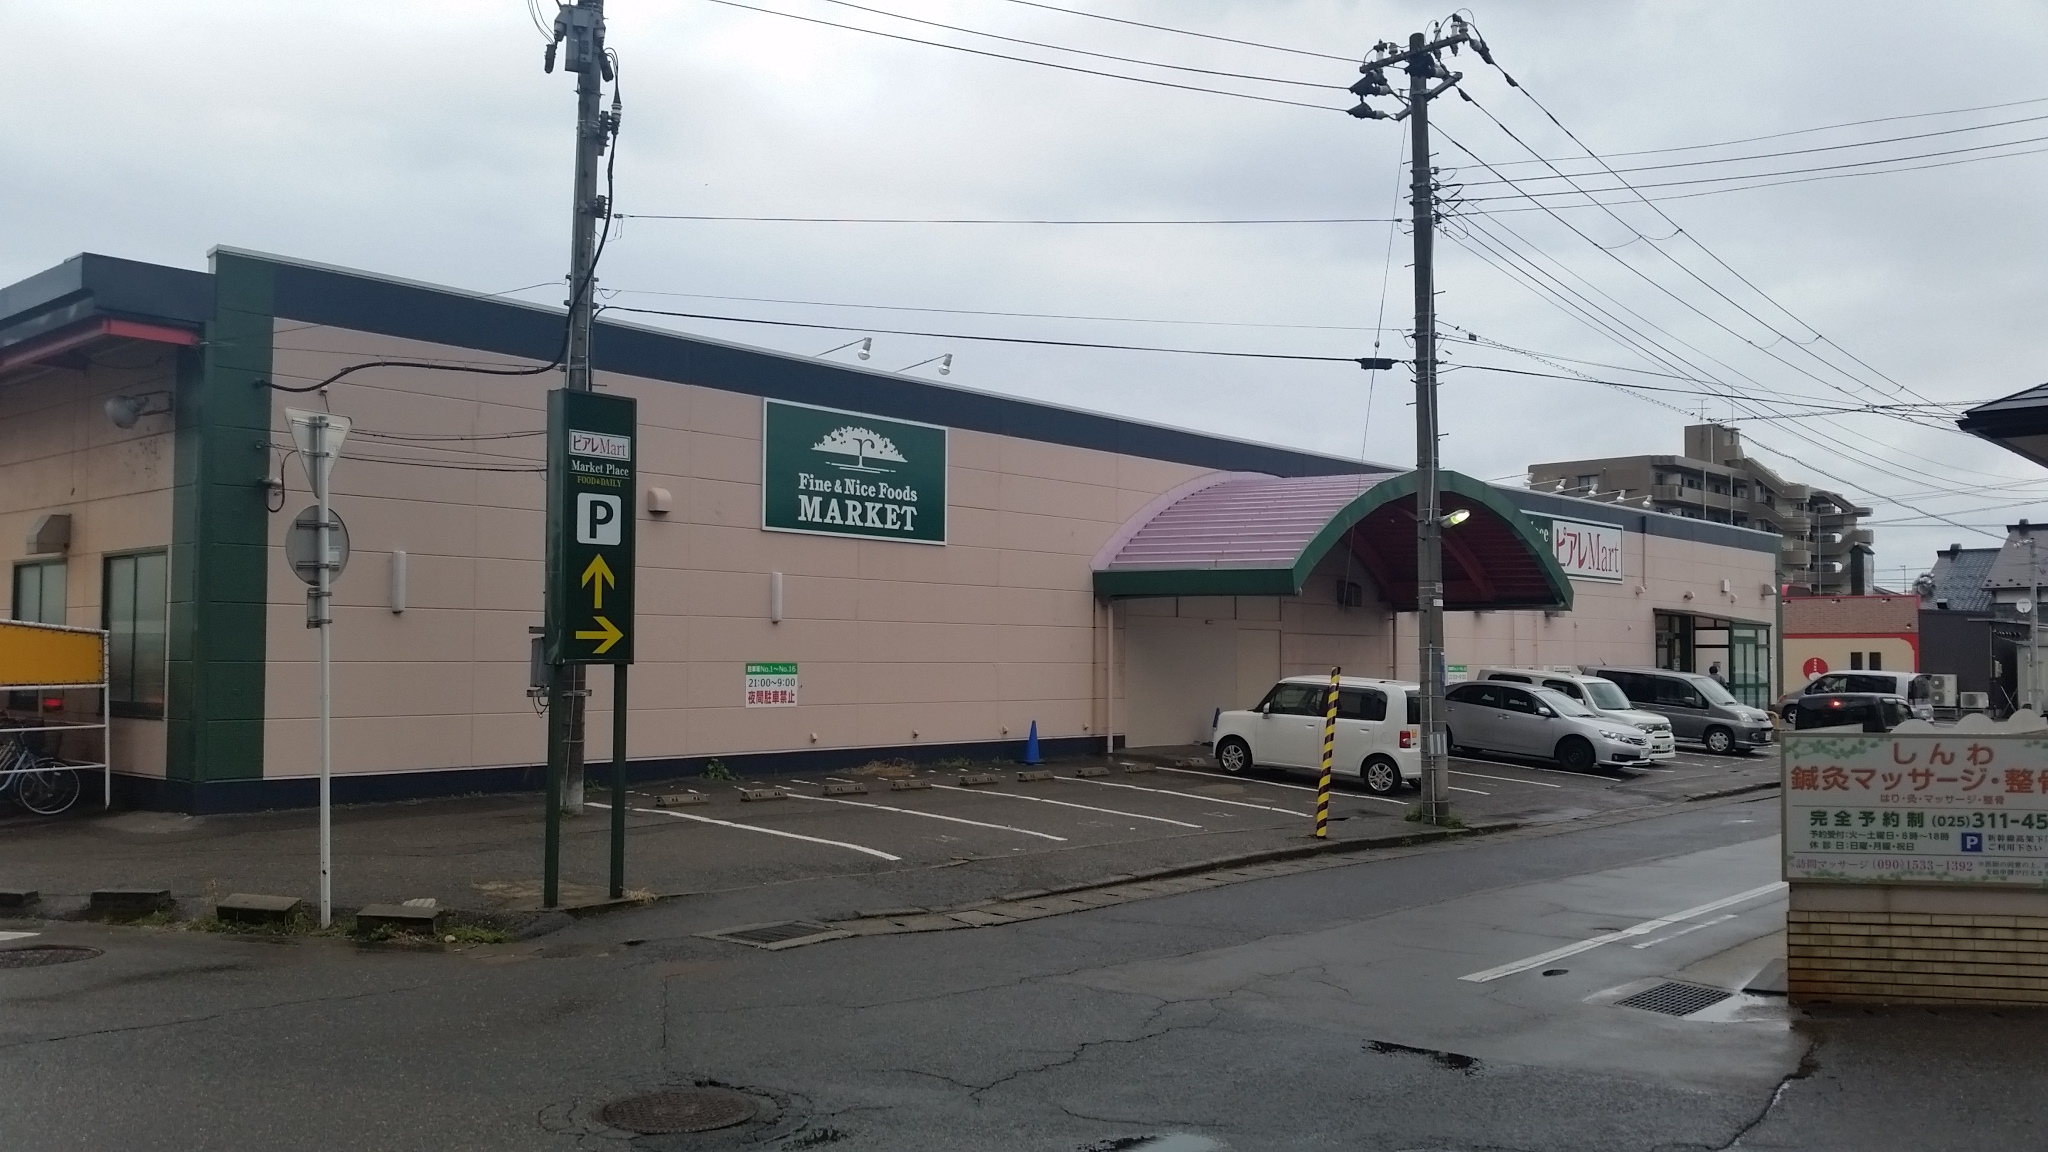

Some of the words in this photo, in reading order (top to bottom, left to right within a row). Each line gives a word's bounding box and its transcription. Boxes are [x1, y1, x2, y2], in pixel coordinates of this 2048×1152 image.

[573, 434, 626, 457] ピアレMart
[571, 460, 603, 474] Market
[606, 463, 629, 476] Place
[798, 472, 832, 493] Fine
[833, 480, 843, 494] &
[844, 478, 876, 498] Nice
[878, 482, 918, 502] Foods
[589, 500, 613, 539] P
[797, 494, 918, 531] MARKET
[1556, 526, 1619, 573] ピアレMart
[748, 690, 796, 704] 夜間駐車禁止
[1893, 742, 1994, 766] しんわ
[1810, 810, 1924, 828] 完全予約制
[1966, 836, 1979, 849] P
[1987, 834, 2048, 843] 新幹線高架下
